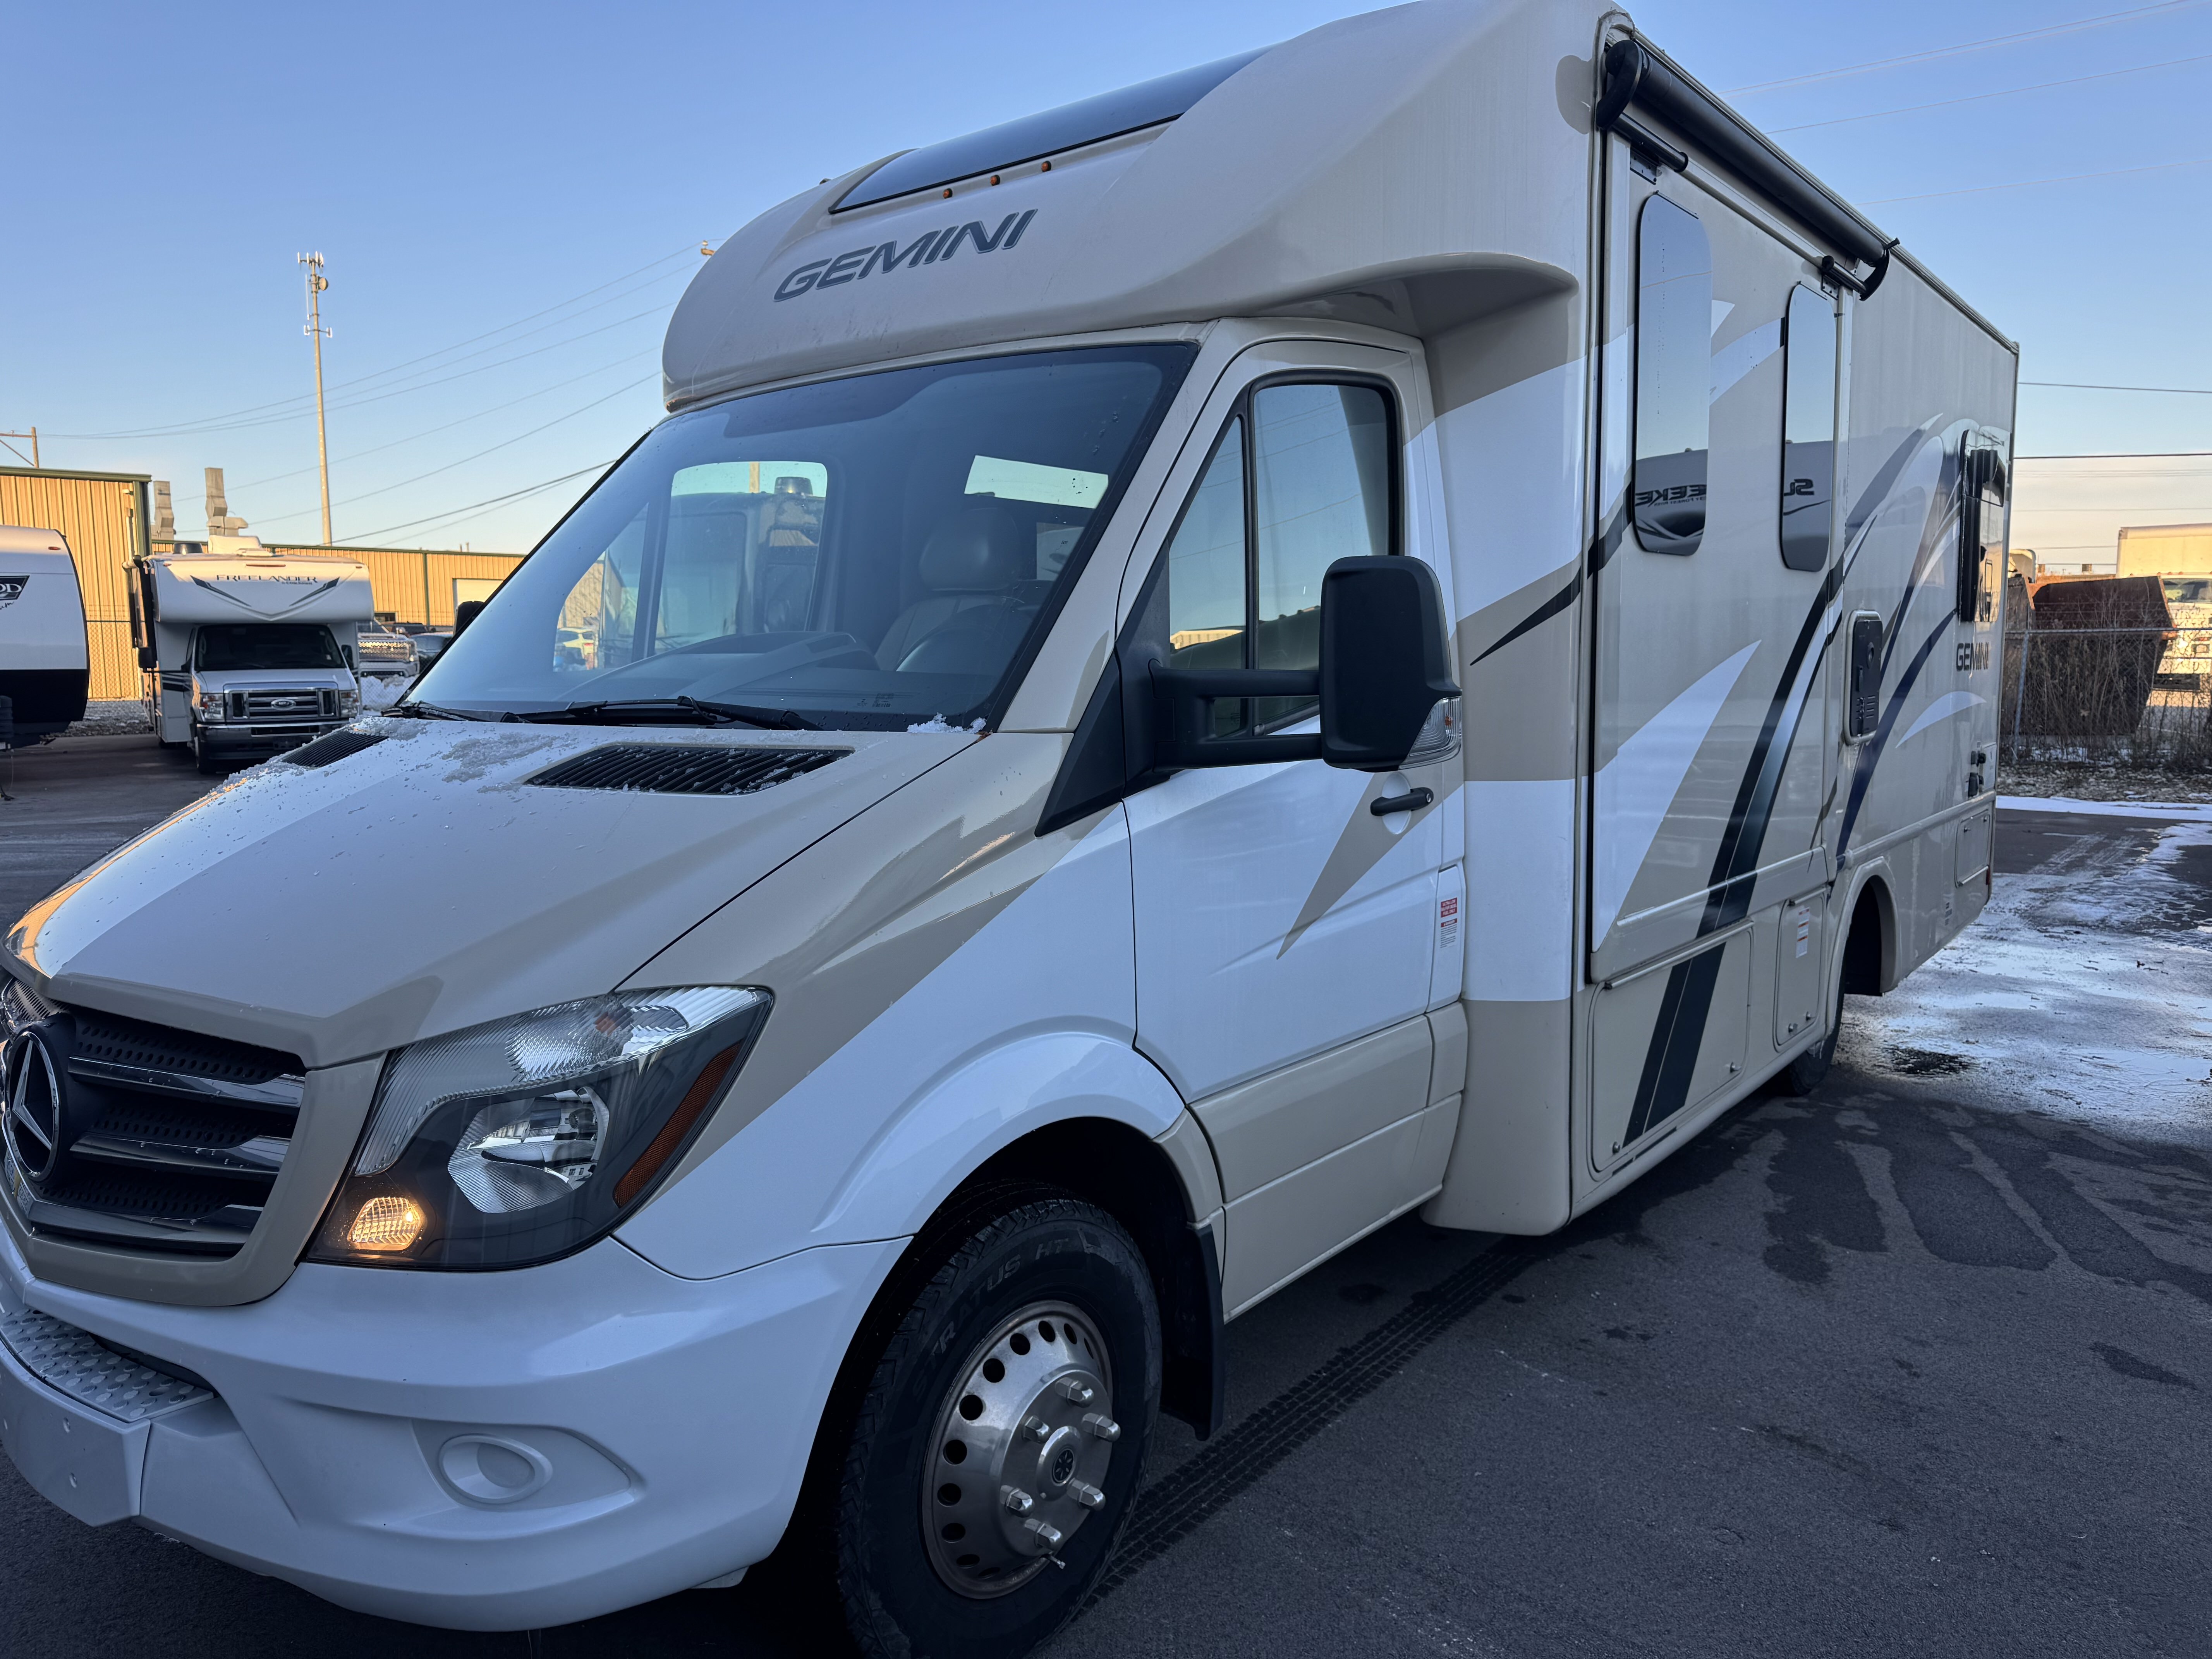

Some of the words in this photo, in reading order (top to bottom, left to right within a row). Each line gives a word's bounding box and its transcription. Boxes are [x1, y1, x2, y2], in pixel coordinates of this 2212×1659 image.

[773, 208, 1038, 302] GEMINI
[216, 574, 318, 583] FREELANDER
[1956, 642, 1989, 671] GEMINI
[1035, 1238, 1070, 1261] HT
